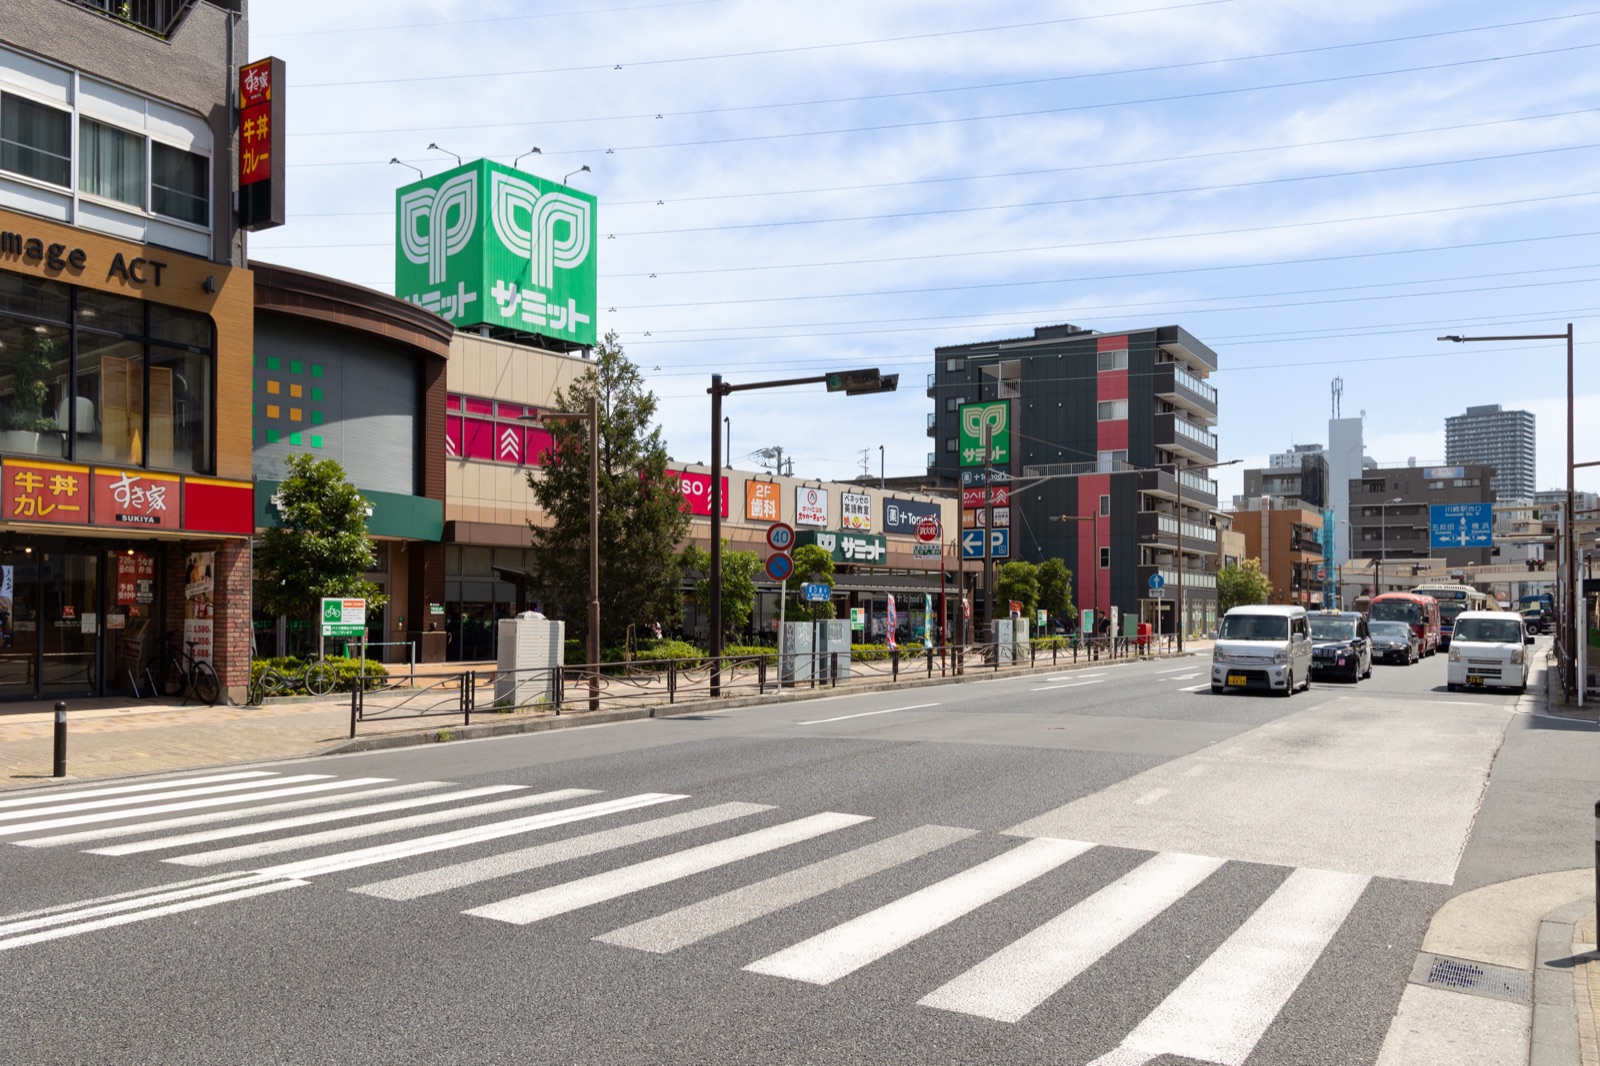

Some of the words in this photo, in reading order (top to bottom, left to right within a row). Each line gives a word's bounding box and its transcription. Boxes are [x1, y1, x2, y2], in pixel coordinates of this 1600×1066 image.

[244, 69, 268, 93] すき家
[243, 113, 269, 144] 牛丼
[242, 147, 269, 175] カレー
[1, 231, 87, 271] mage
[108, 252, 168, 287] ACT
[491, 279, 590, 333] サミット
[14, 471, 79, 497] 牛丼
[109, 471, 167, 514] すき家
[756, 484, 771, 498] 2F
[13, 494, 81, 516] カレー
[750, 498, 776, 519] 歯科
[844, 503, 870, 515] 英語教室
[121, 514, 155, 523] SUKIYA
[1432, 523, 1455, 531] 五反田
[1471, 522, 1490, 530] 横浜
[772, 530, 789, 541] 40
[919, 526, 936, 536] 消火栓
[841, 536, 886, 561] サミット
